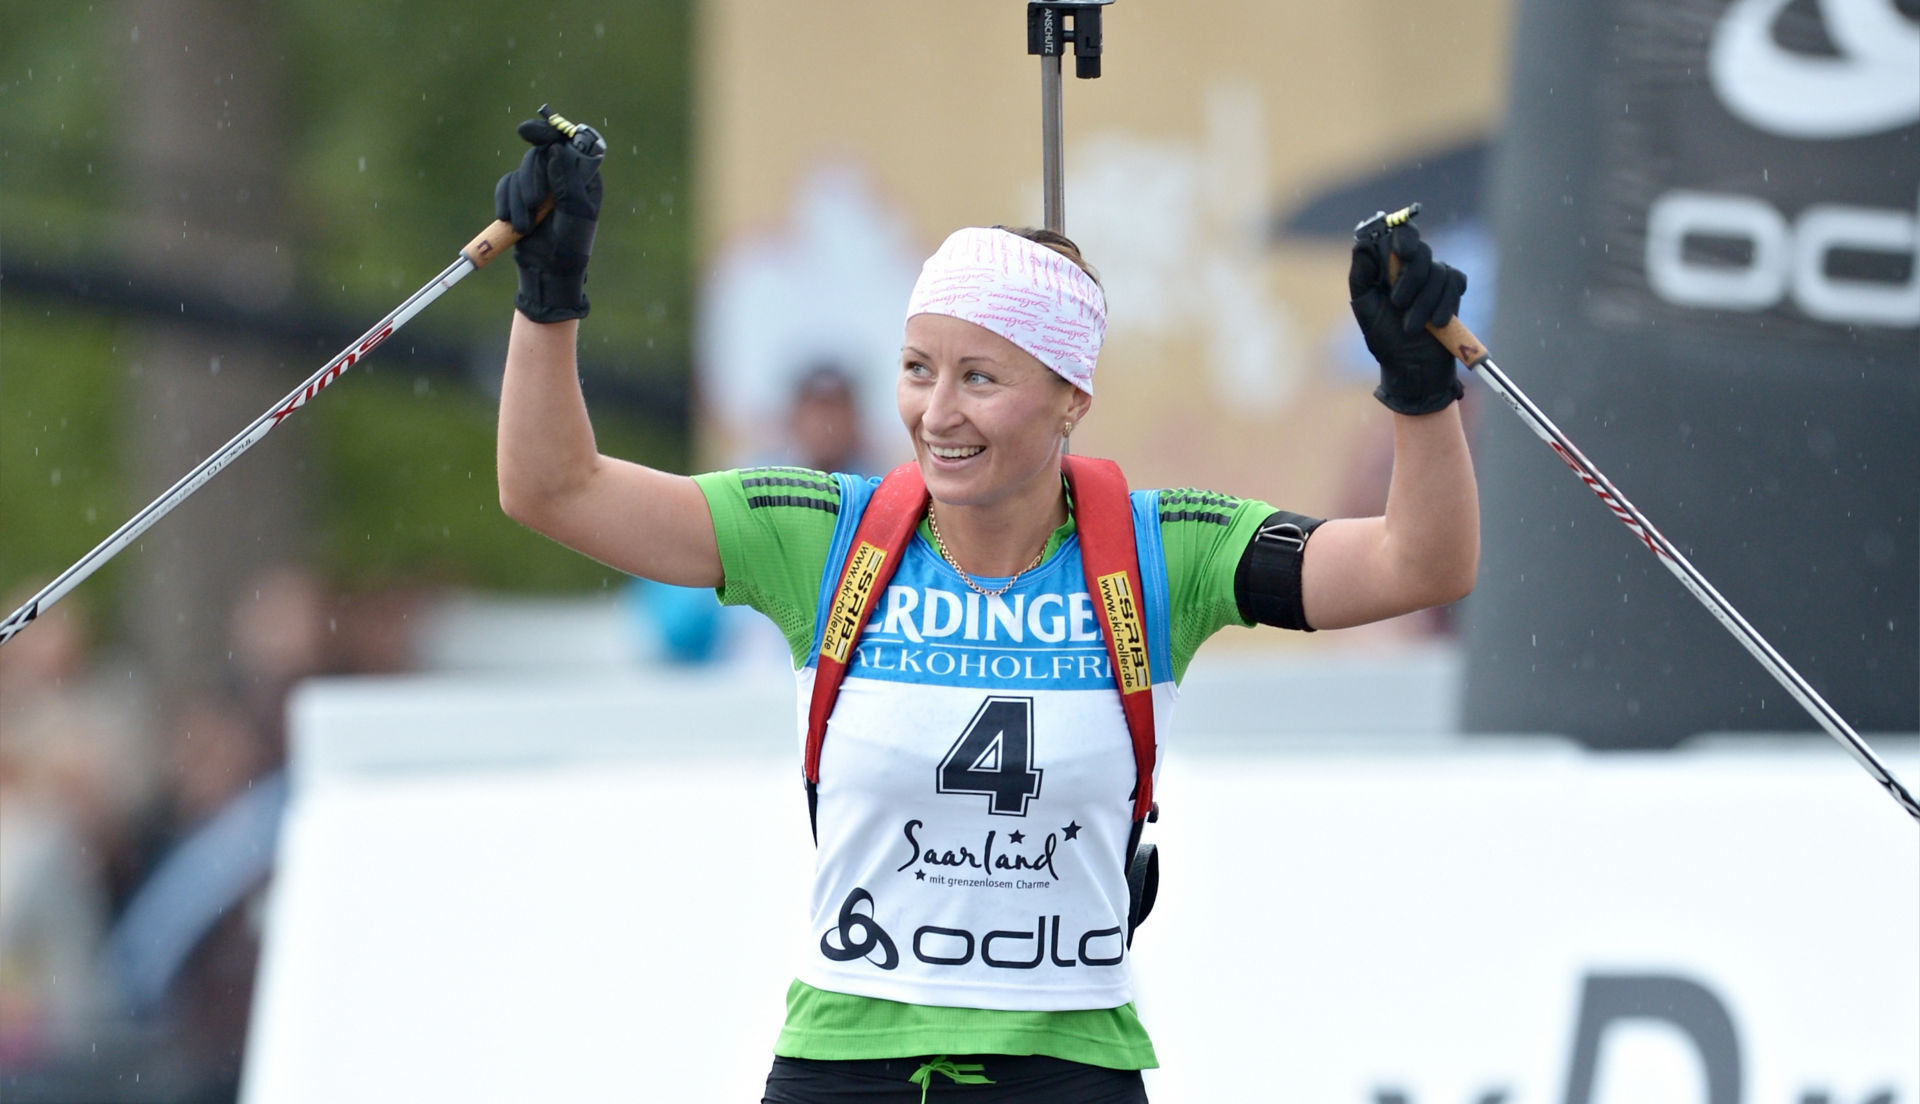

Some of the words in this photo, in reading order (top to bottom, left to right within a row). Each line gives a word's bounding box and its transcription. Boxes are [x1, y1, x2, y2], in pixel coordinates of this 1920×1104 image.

[973, 312, 1037, 332] Salomon
[825, 545, 868, 650] www.ski-roller.de
[839, 569, 873, 639] SRB
[861, 588, 1107, 644] RDINGE
[1100, 578, 1134, 688] www.ski-roller.de
[1119, 596, 1145, 668] SRB
[936, 695, 1044, 817] 4
[897, 819, 1059, 881] Saarland
[929, 875, 945, 885] mit
[948, 877, 1013, 889] grenzenlosem
[1016, 880, 1050, 889] Charme
[912, 914, 1124, 970] odlo
